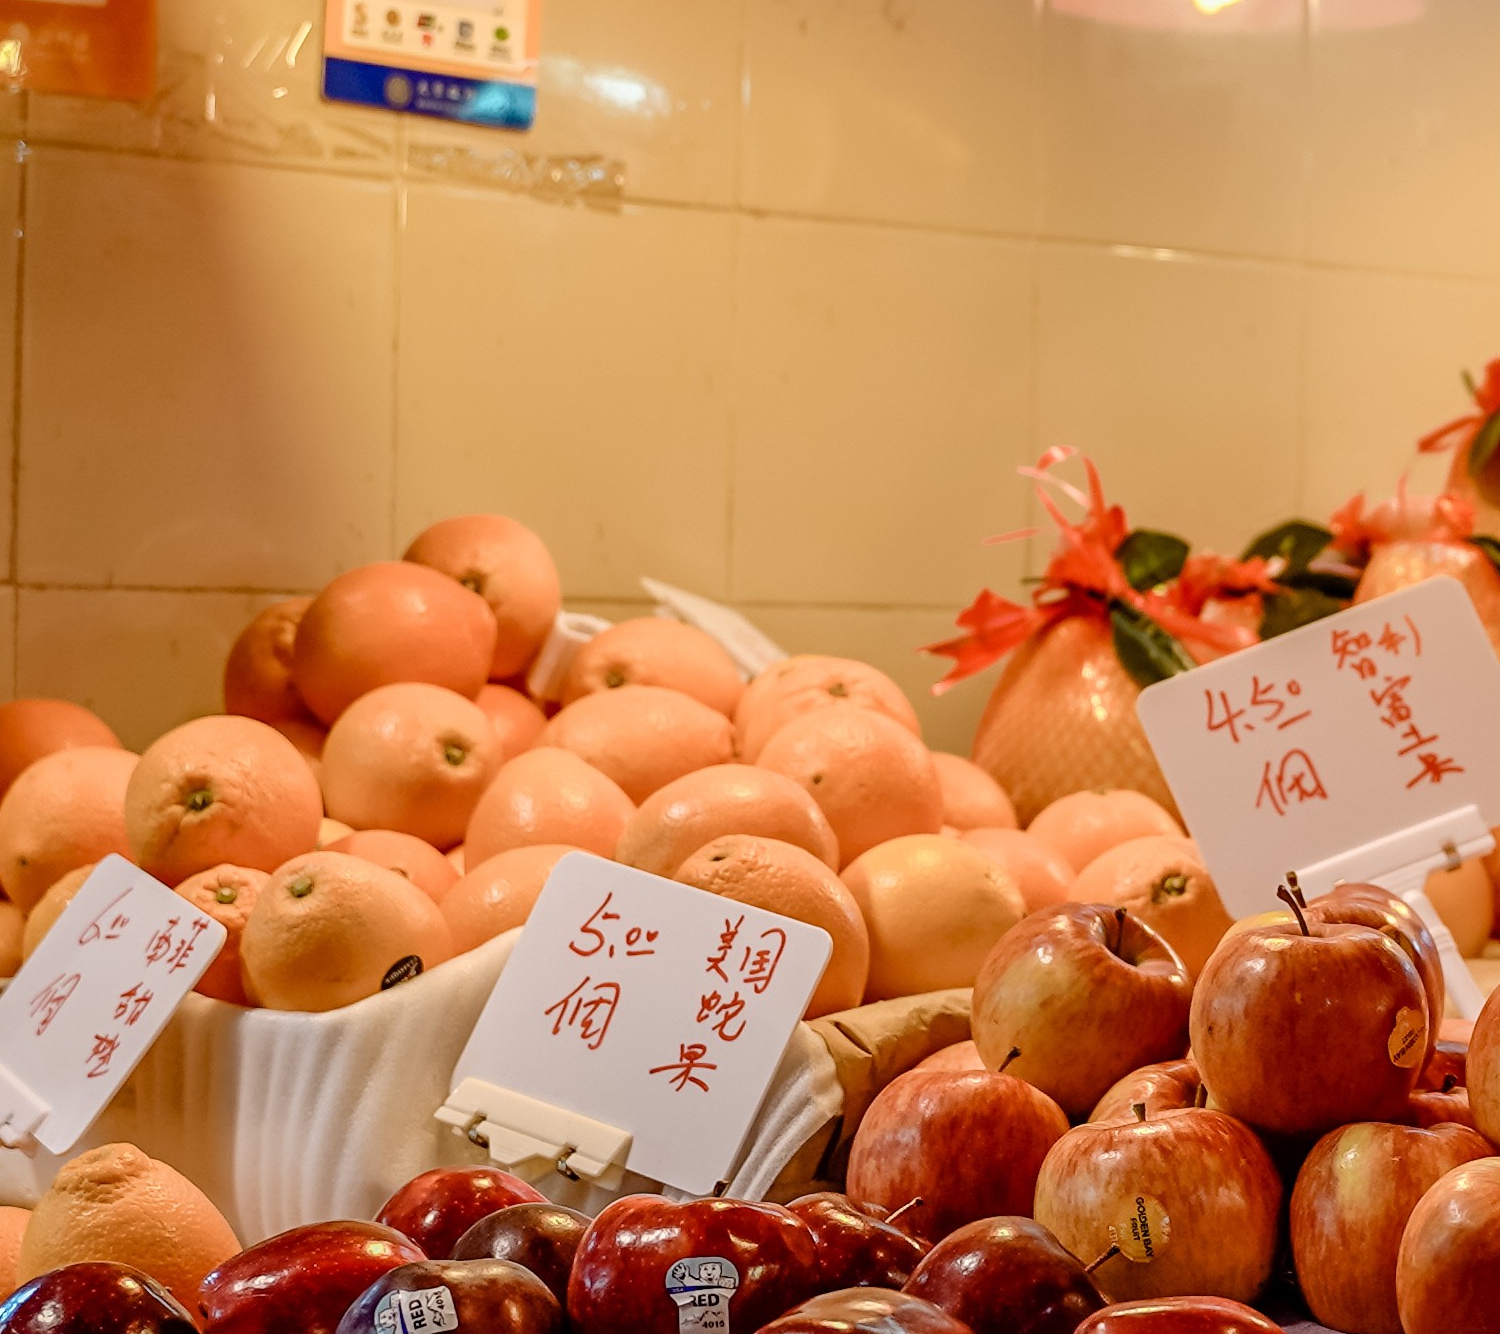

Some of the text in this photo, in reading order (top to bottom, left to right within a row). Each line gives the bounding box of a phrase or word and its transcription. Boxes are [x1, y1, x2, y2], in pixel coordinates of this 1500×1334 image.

[1130, 1217, 1141, 1242] FRUIT
[1135, 1196, 1155, 1258] GOLDEN BAY
[408, 1298, 428, 1331] RED
